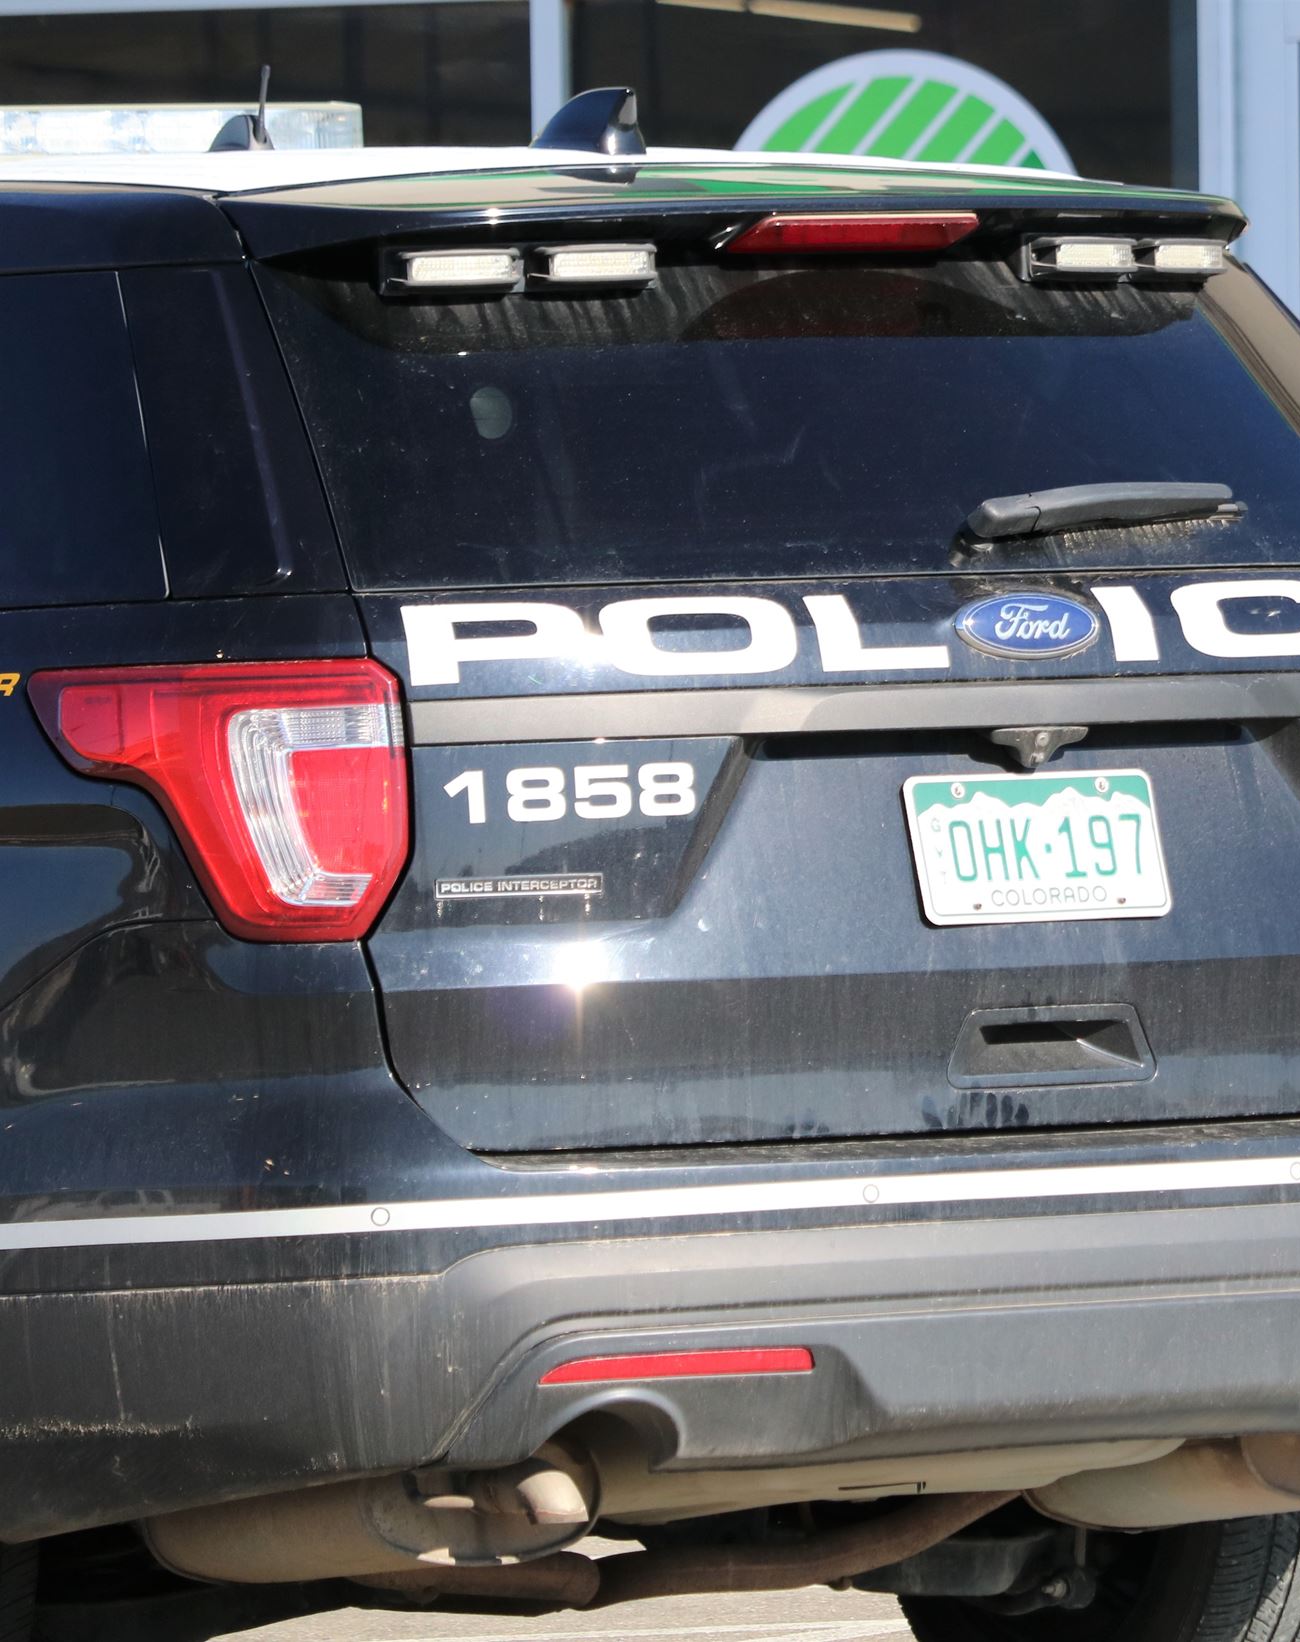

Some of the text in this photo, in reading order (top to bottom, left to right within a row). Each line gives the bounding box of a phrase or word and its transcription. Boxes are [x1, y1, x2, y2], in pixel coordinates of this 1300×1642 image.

[994, 603, 1071, 640] Ford
[443, 762, 696, 824] 1858
[441, 878, 598, 893] POLICE INTERCEPTOR
[991, 885, 1108, 907] COLORADO
